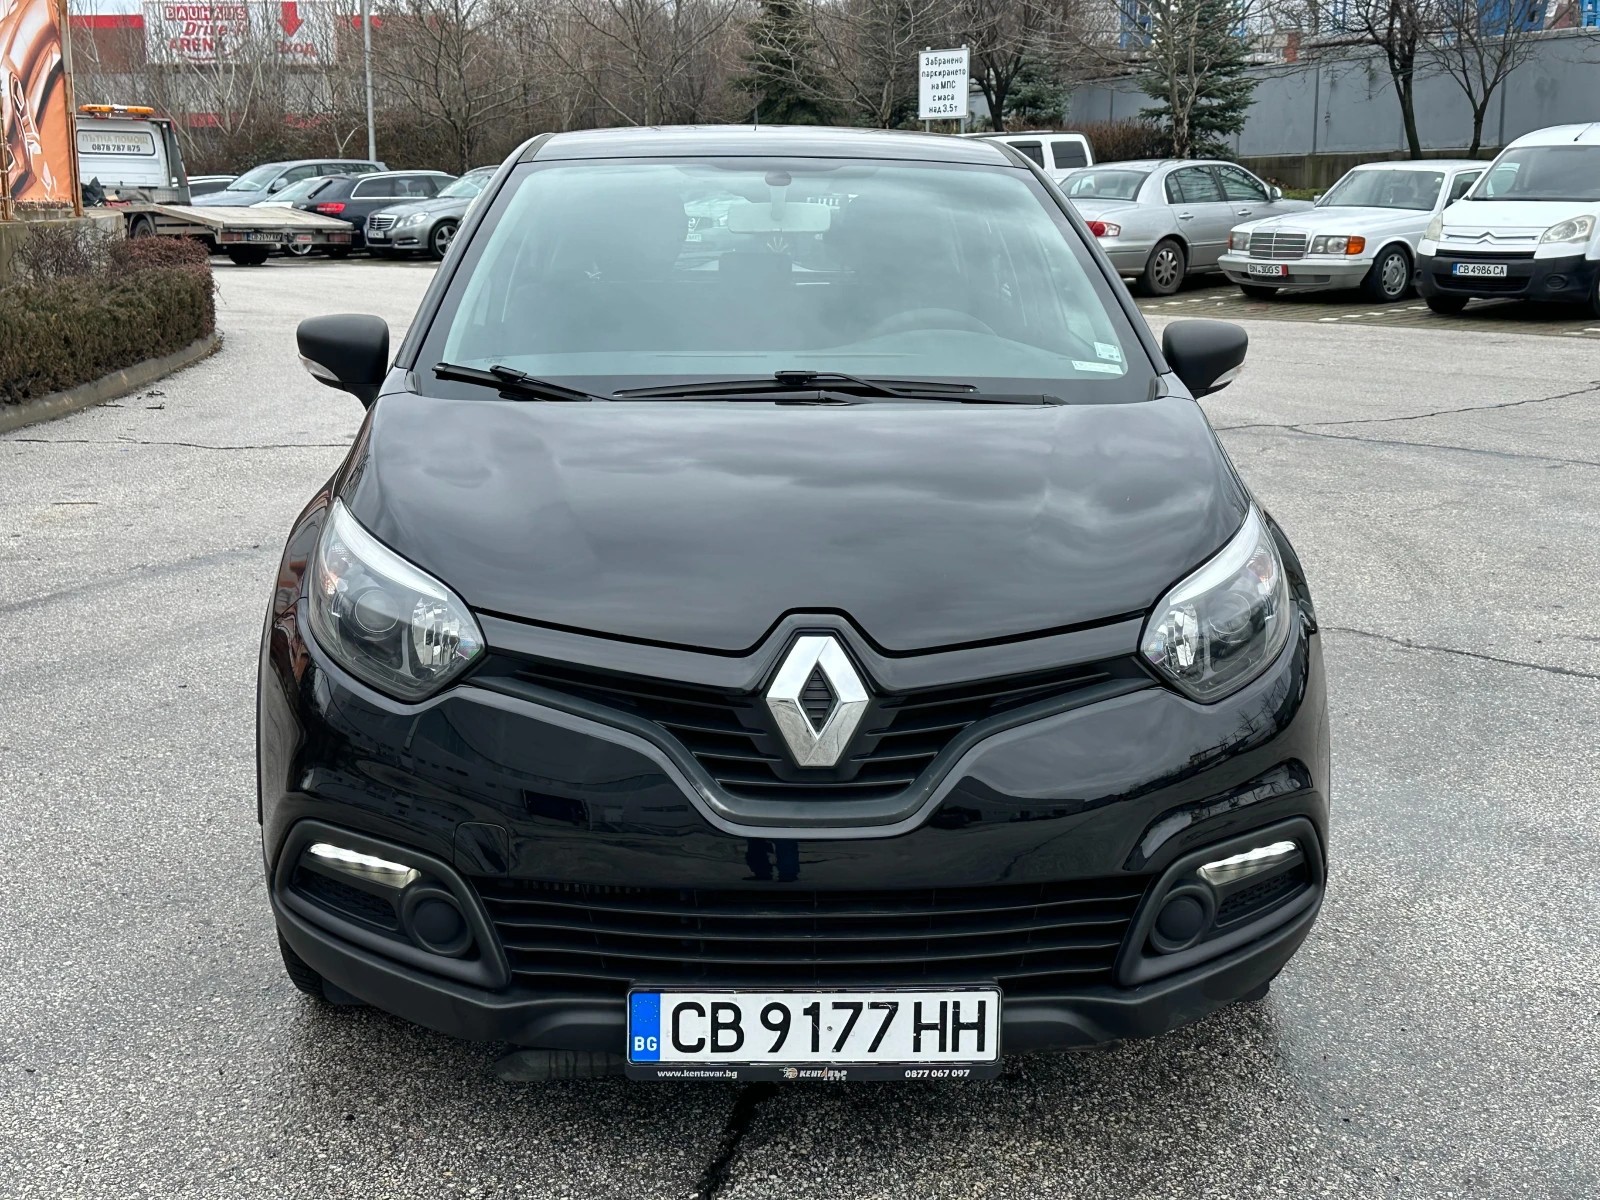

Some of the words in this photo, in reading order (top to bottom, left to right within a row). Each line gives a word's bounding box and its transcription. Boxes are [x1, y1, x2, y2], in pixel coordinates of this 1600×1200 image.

[165, 6, 247, 20] BAUHAUS
[925, 56, 964, 67] Забранено
[921, 68, 967, 78] паркирането
[940, 80, 956, 90] МПС
[928, 106, 942, 114] над
[1470, 265, 1492, 275] 4986
[670, 1001, 744, 1053] CB
[759, 1000, 900, 1053] 9177
[912, 1000, 986, 1053] HH
[634, 1036, 657, 1051] BG
[656, 1069, 738, 1079] www.kentavar.bg
[905, 1069, 929, 1078] 0877
[931, 1069, 949, 1078] 067
[951, 1069, 970, 1077] 097
